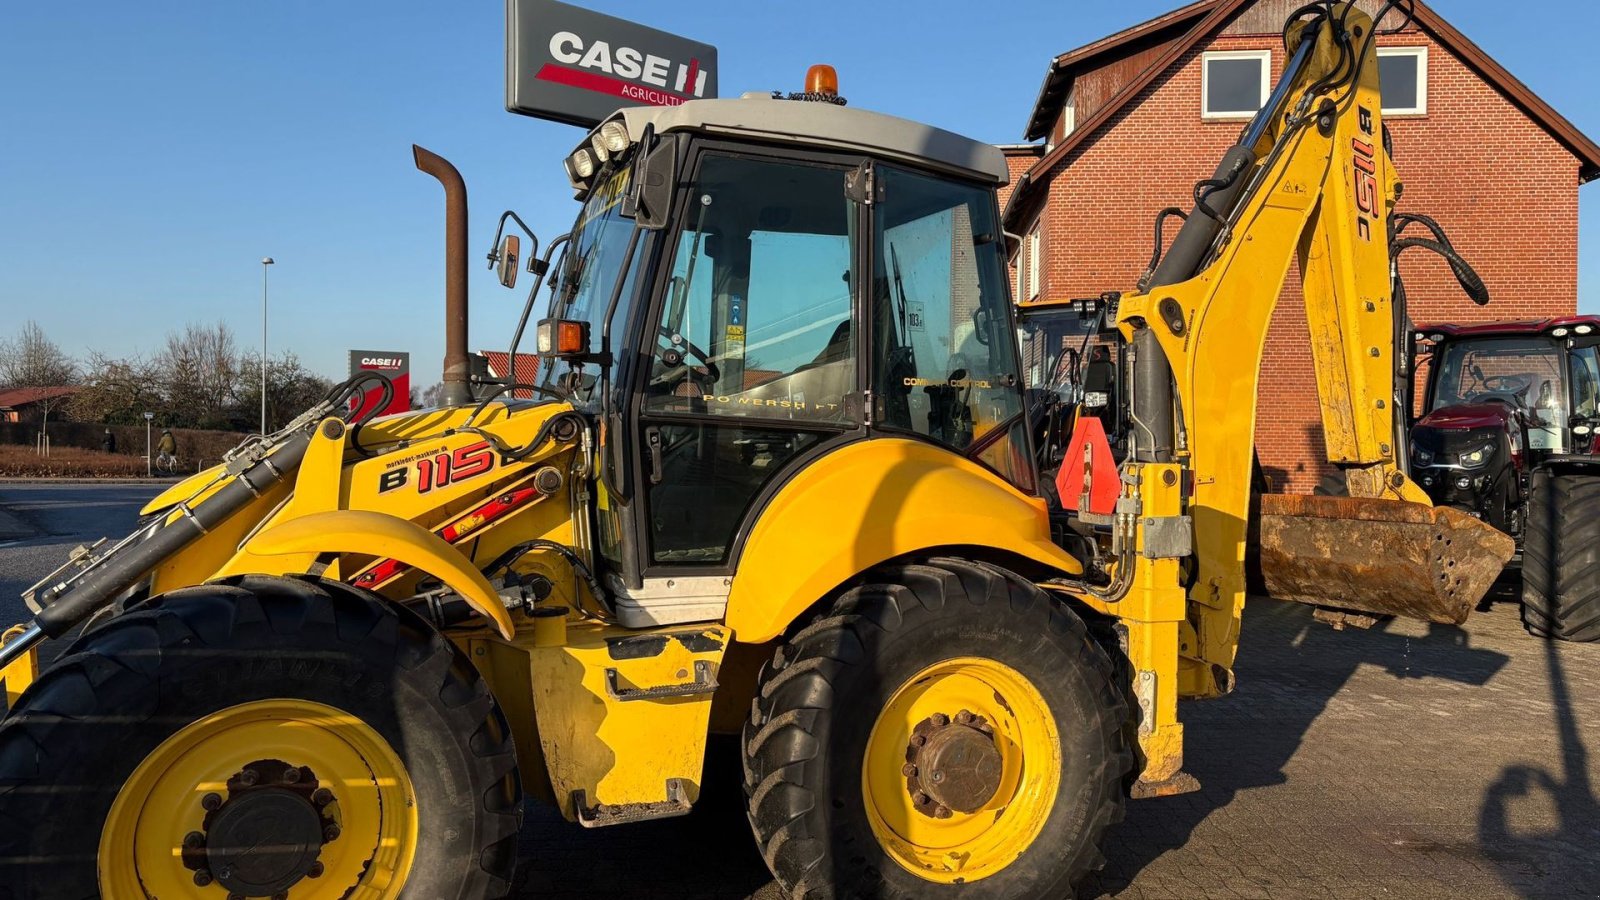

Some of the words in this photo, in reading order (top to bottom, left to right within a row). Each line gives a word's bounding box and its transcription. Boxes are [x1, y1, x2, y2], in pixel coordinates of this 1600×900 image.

[549, 31, 671, 87] CASE
[621, 84, 688, 107] AGRICULTU
[1358, 104, 1373, 136] B
[1352, 137, 1379, 219] 115
[361, 357, 393, 366] CASE
[379, 467, 408, 494] B
[417, 440, 495, 494] 115
